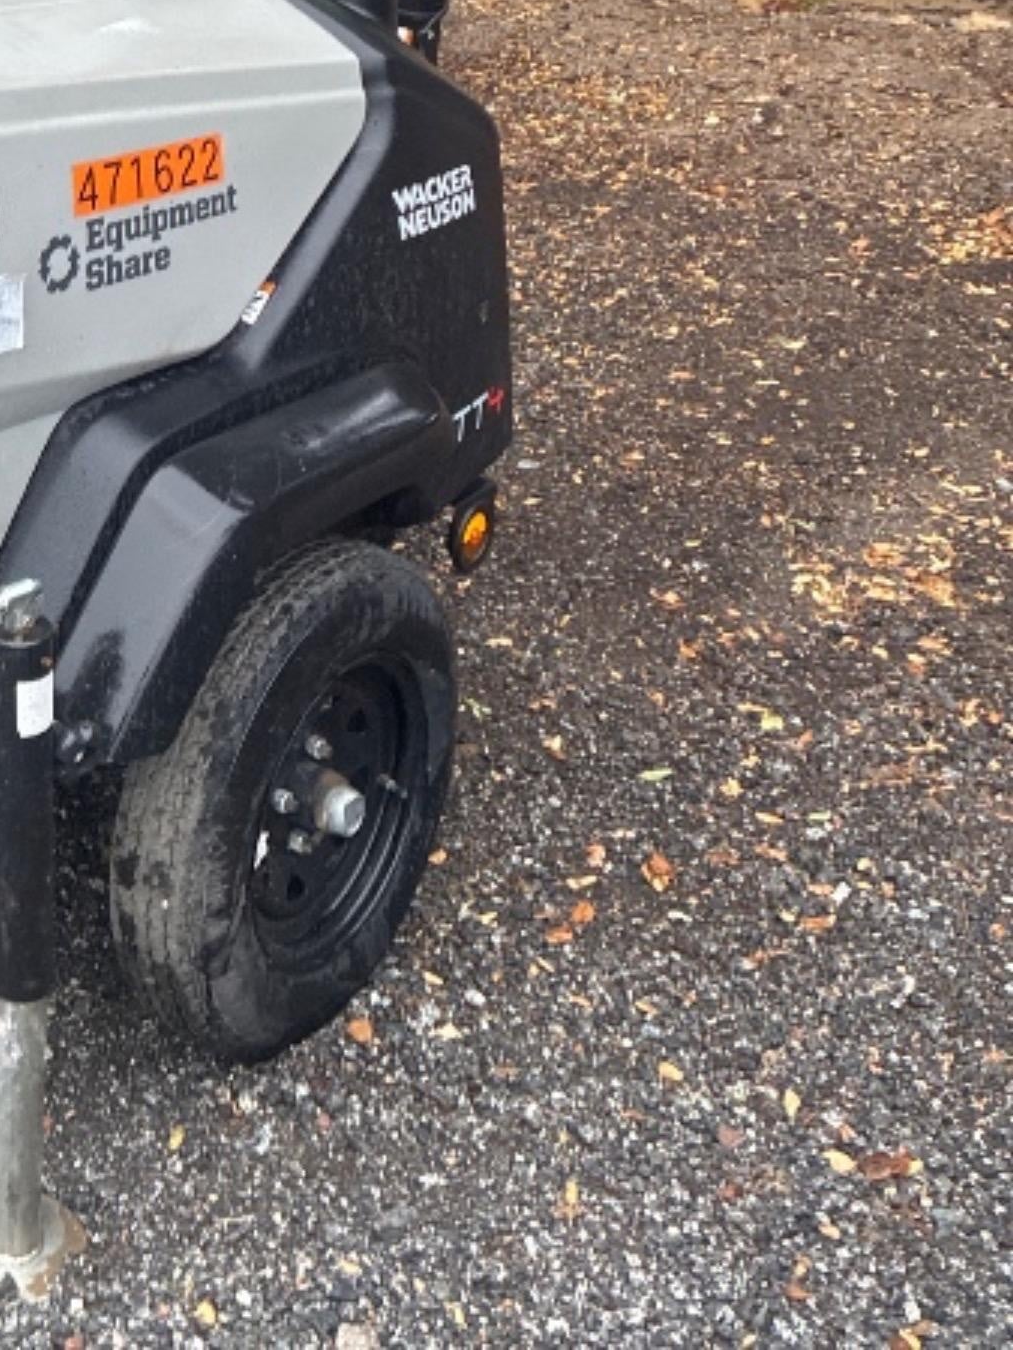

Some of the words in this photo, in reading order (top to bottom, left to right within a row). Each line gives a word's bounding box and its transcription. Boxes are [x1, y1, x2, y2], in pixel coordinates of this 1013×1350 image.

[78, 138, 219, 210] 471622
[392, 164, 472, 212] WACKER
[85, 184, 237, 253] Equipment
[398, 188, 476, 241] NEUSON
[85, 246, 171, 291] Share
